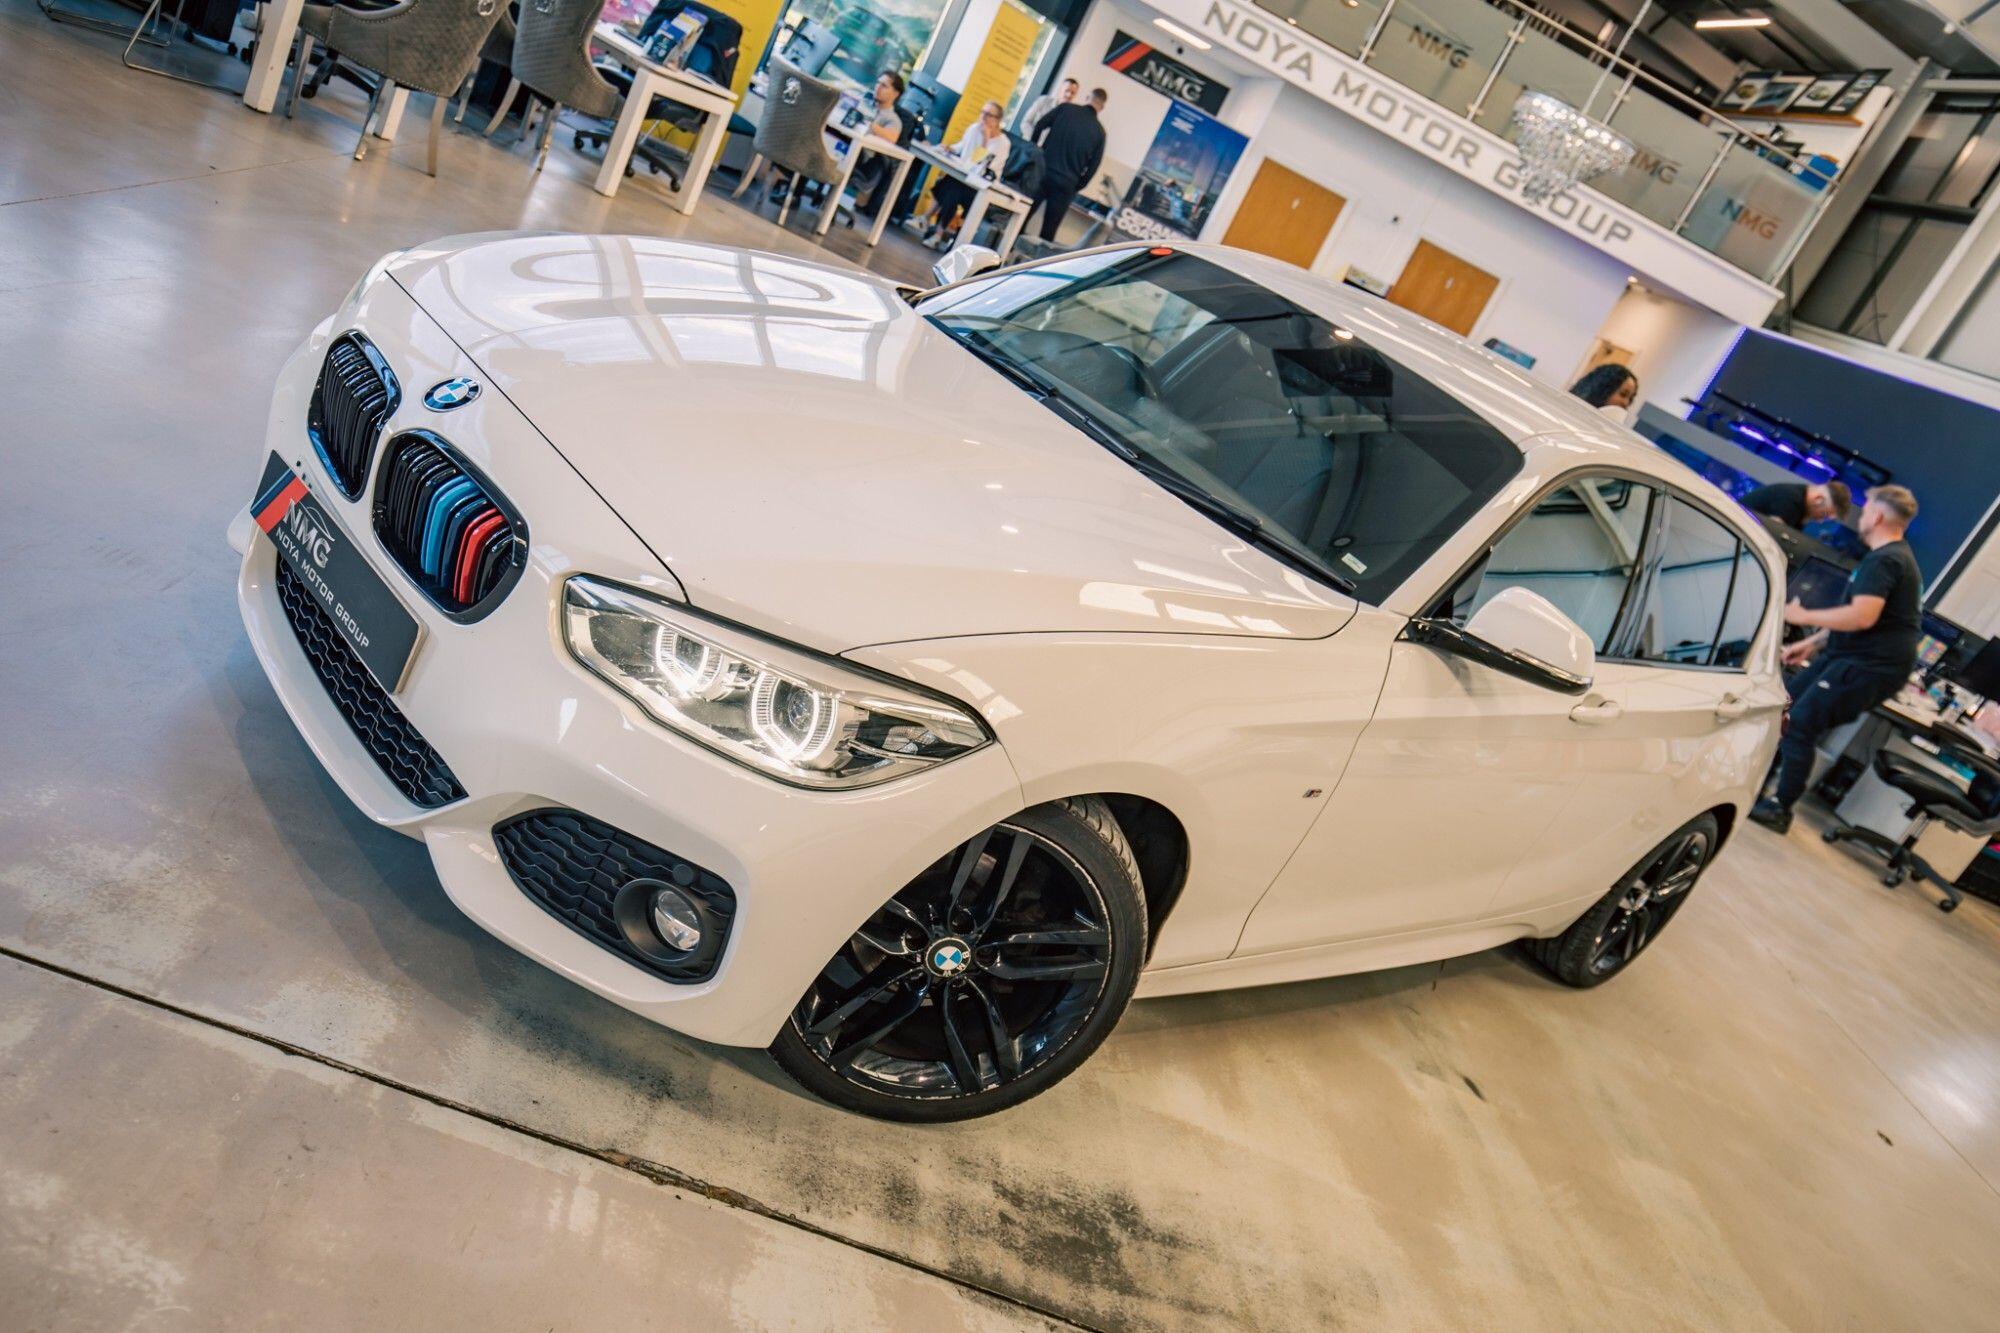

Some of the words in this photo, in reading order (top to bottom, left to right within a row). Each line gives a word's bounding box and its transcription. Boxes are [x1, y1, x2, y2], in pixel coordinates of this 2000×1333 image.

[1408, 25, 1470, 69] NMG
[1142, 59, 1203, 101] NMG
[1204, 1, 1314, 81] NOYA
[1332, 71, 1480, 168] MOTOR
[1493, 160, 1633, 242] GOUP
[1721, 199, 1778, 240] NMG
[283, 498, 331, 568] NMG
[275, 527, 299, 562] NOYA
[301, 558, 334, 605] MOTOR
[335, 602, 370, 647] GROUP
